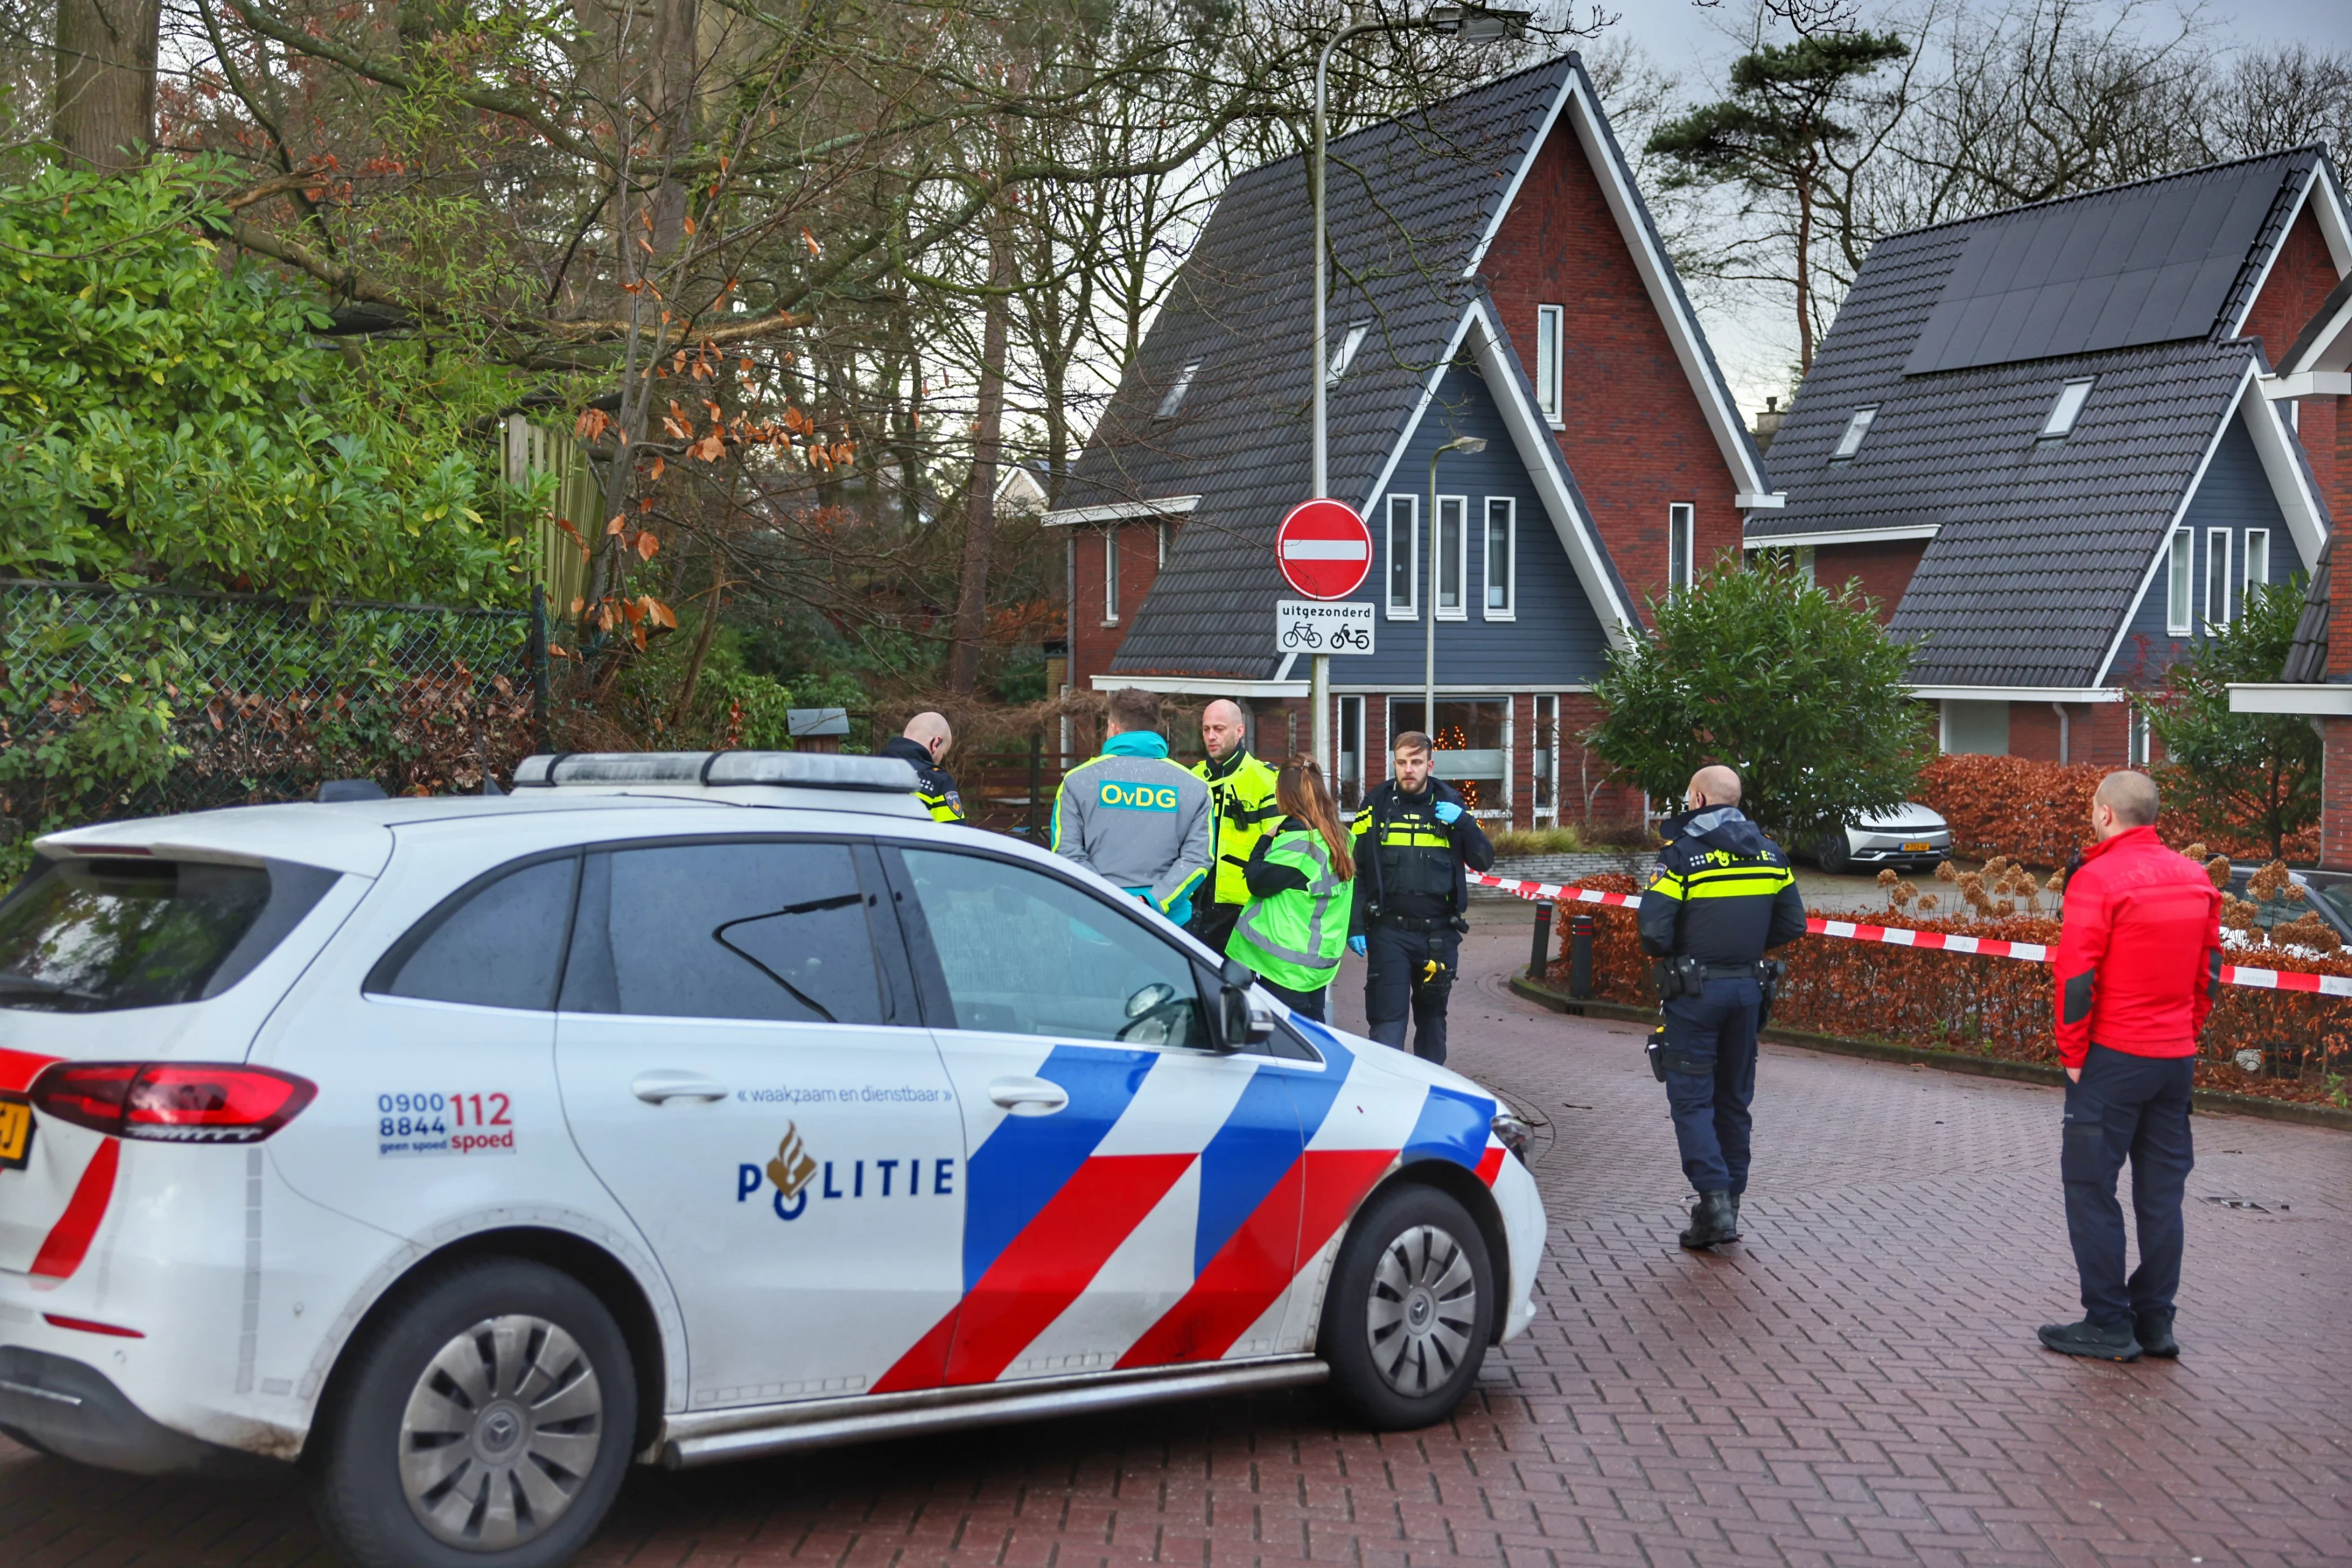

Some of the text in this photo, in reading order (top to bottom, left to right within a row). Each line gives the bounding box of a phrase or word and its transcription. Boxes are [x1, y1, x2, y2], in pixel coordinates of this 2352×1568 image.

[1283, 606, 1370, 619] uitgezonderd
[1101, 784, 1176, 808] OvDG
[1705, 850, 1769, 867] POLE
[379, 1093, 444, 1113] 0900
[751, 1086, 837, 1104] waakzaam
[840, 1090, 858, 1101] en
[861, 1085, 940, 1102] dienstbaar
[449, 1093, 511, 1126] 112
[380, 1117, 446, 1136] 8844
[380, 1140, 447, 1154] geen spoed
[451, 1129, 513, 1154] spoed
[737, 1158, 954, 1221] POLITIE
